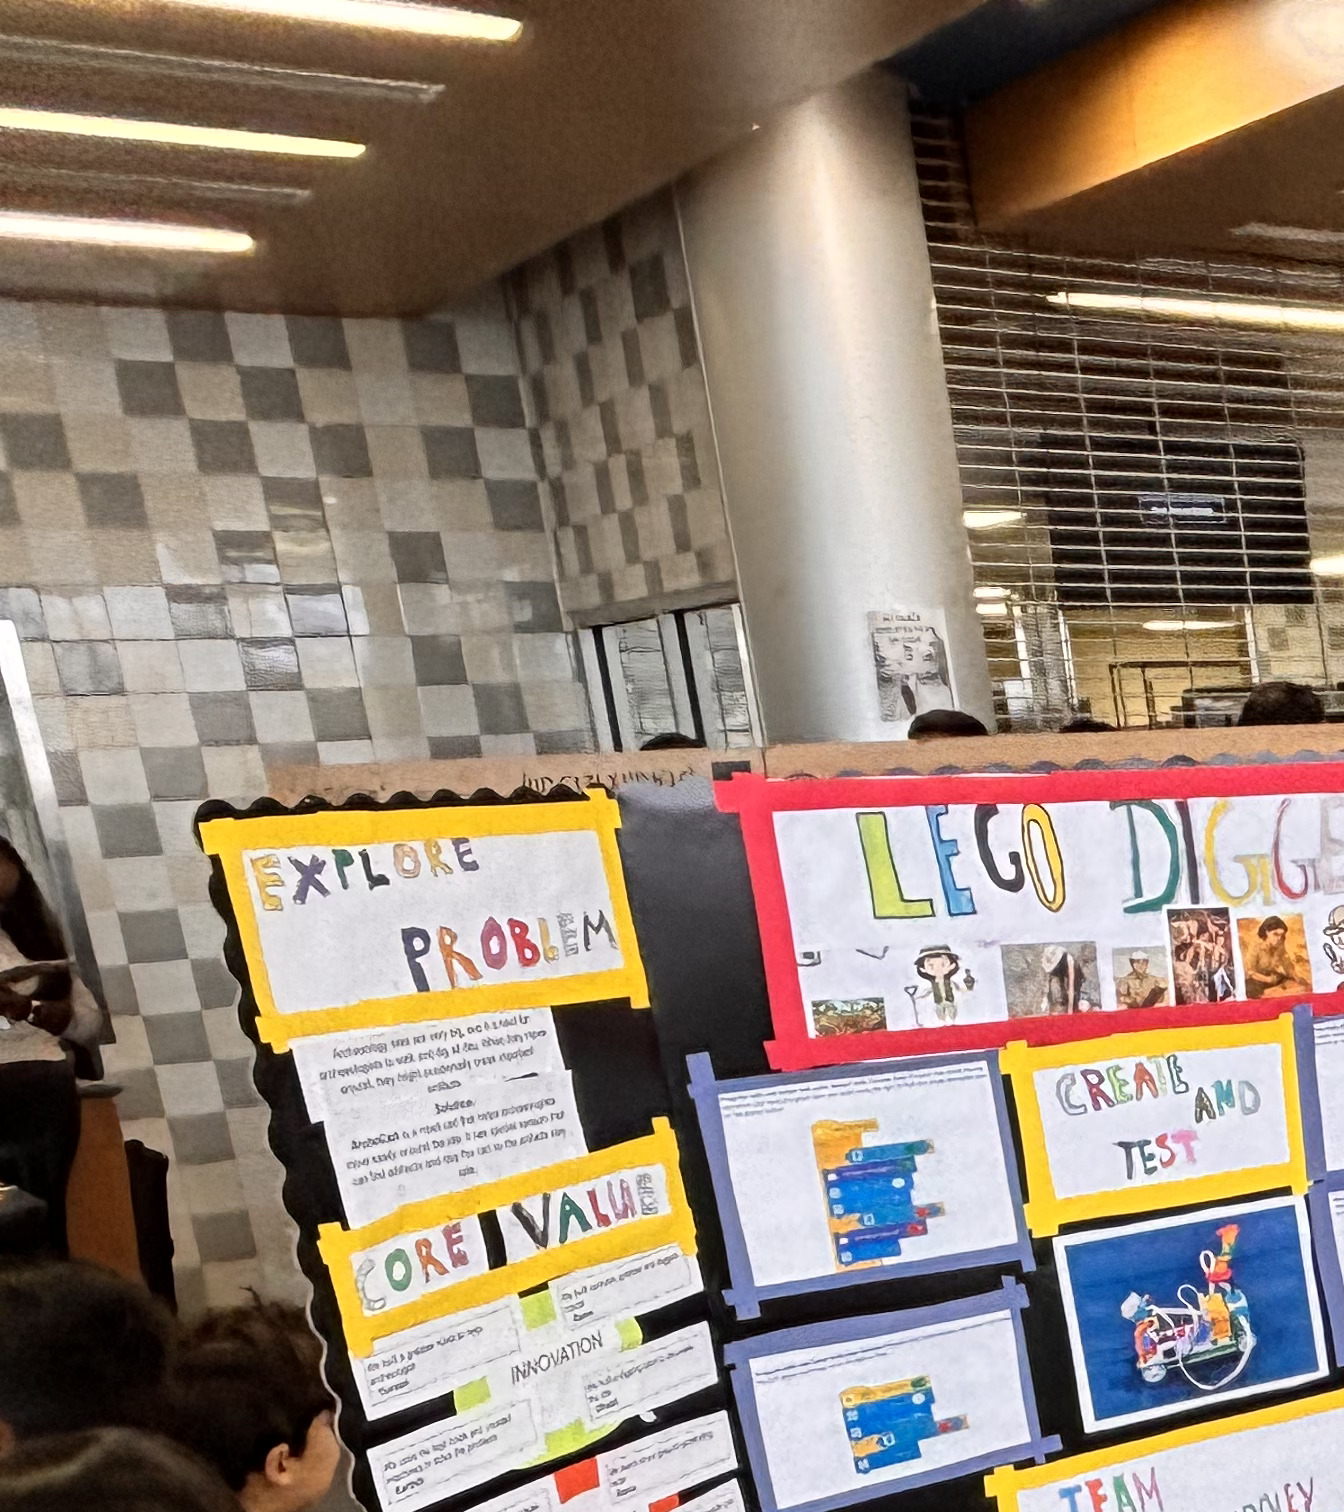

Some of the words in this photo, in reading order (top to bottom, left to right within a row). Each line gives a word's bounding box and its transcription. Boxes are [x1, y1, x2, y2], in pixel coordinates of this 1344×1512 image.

[249, 837, 479, 911] EXPLORE
[855, 802, 1066, 919] LEGO
[401, 909, 617, 992] PROBLEM
[1055, 1054, 1189, 1117] CREATE
[1194, 1079, 1260, 1123] AND
[1114, 1129, 1199, 1180] TEST
[355, 1222, 469, 1311] CORE
[511, 1331, 604, 1384] INNOVATION
